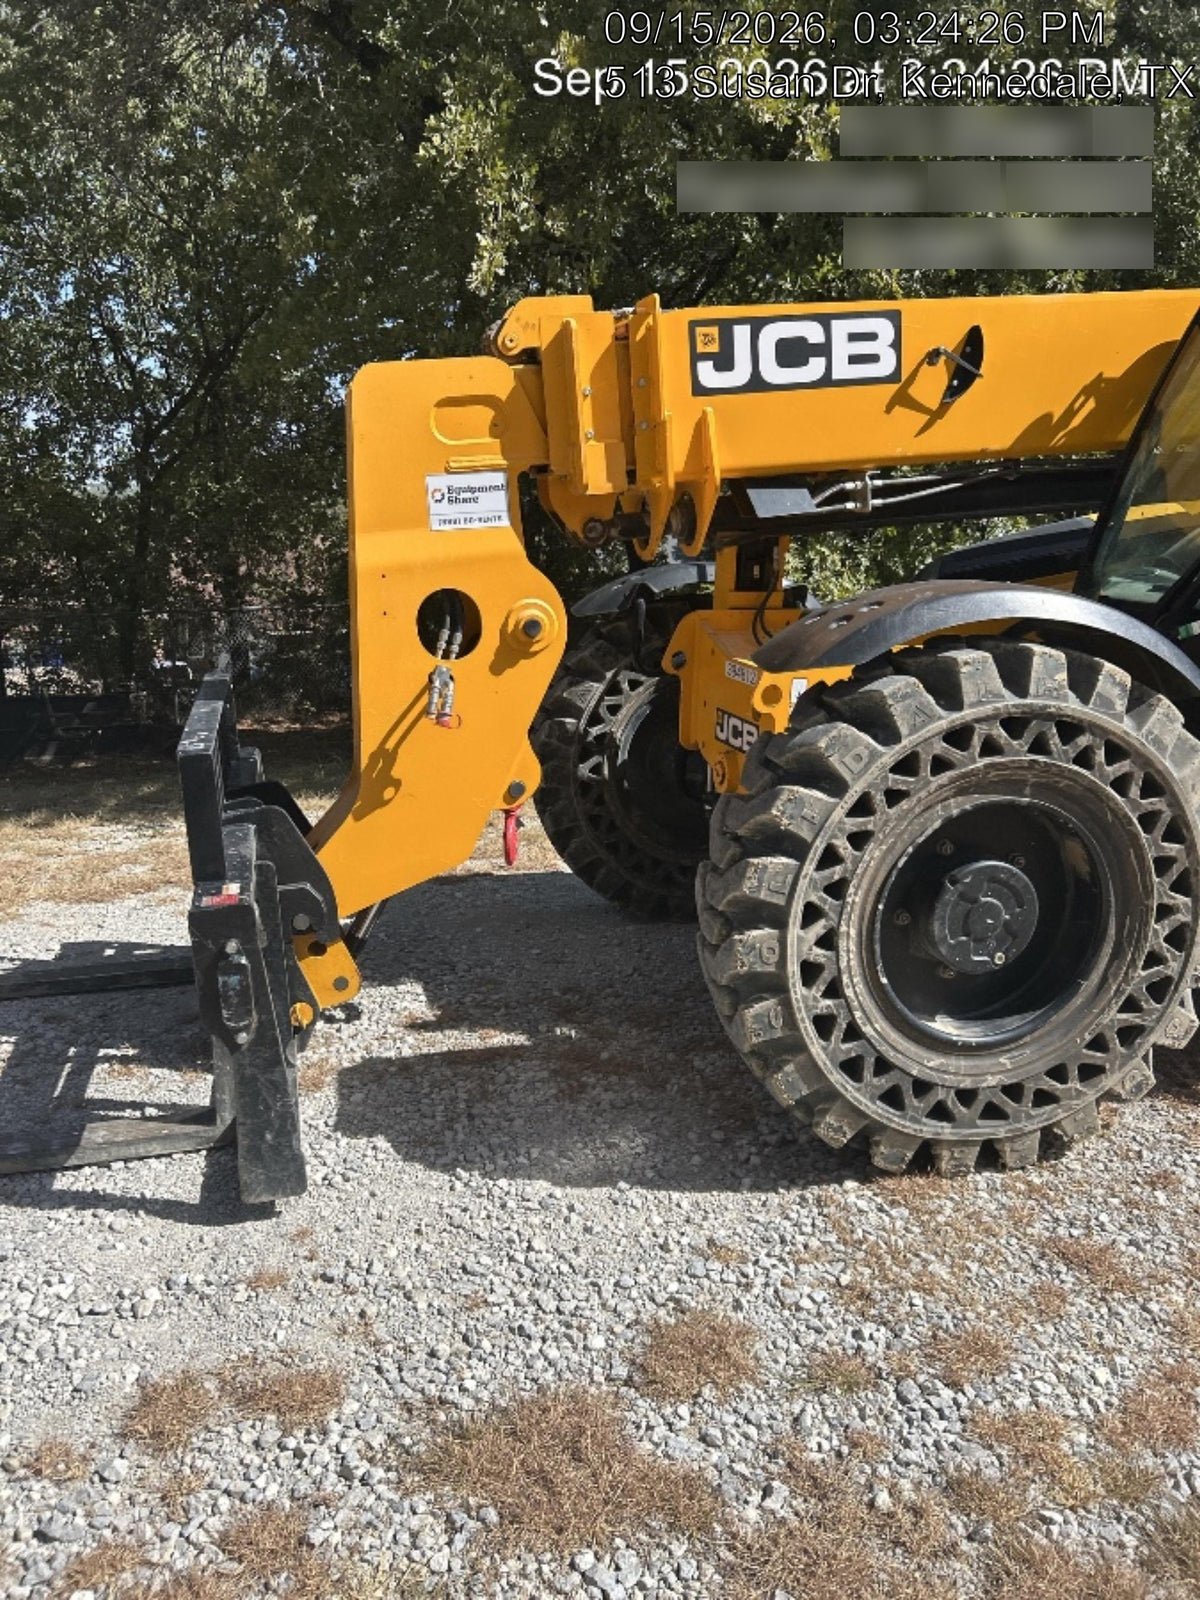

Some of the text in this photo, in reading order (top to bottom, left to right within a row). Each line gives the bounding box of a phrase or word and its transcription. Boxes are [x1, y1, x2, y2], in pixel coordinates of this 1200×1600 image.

[697, 317, 897, 388] JCB
[447, 483, 506, 496] Equipment
[447, 495, 479, 505] Share
[715, 711, 760, 751] JCB
